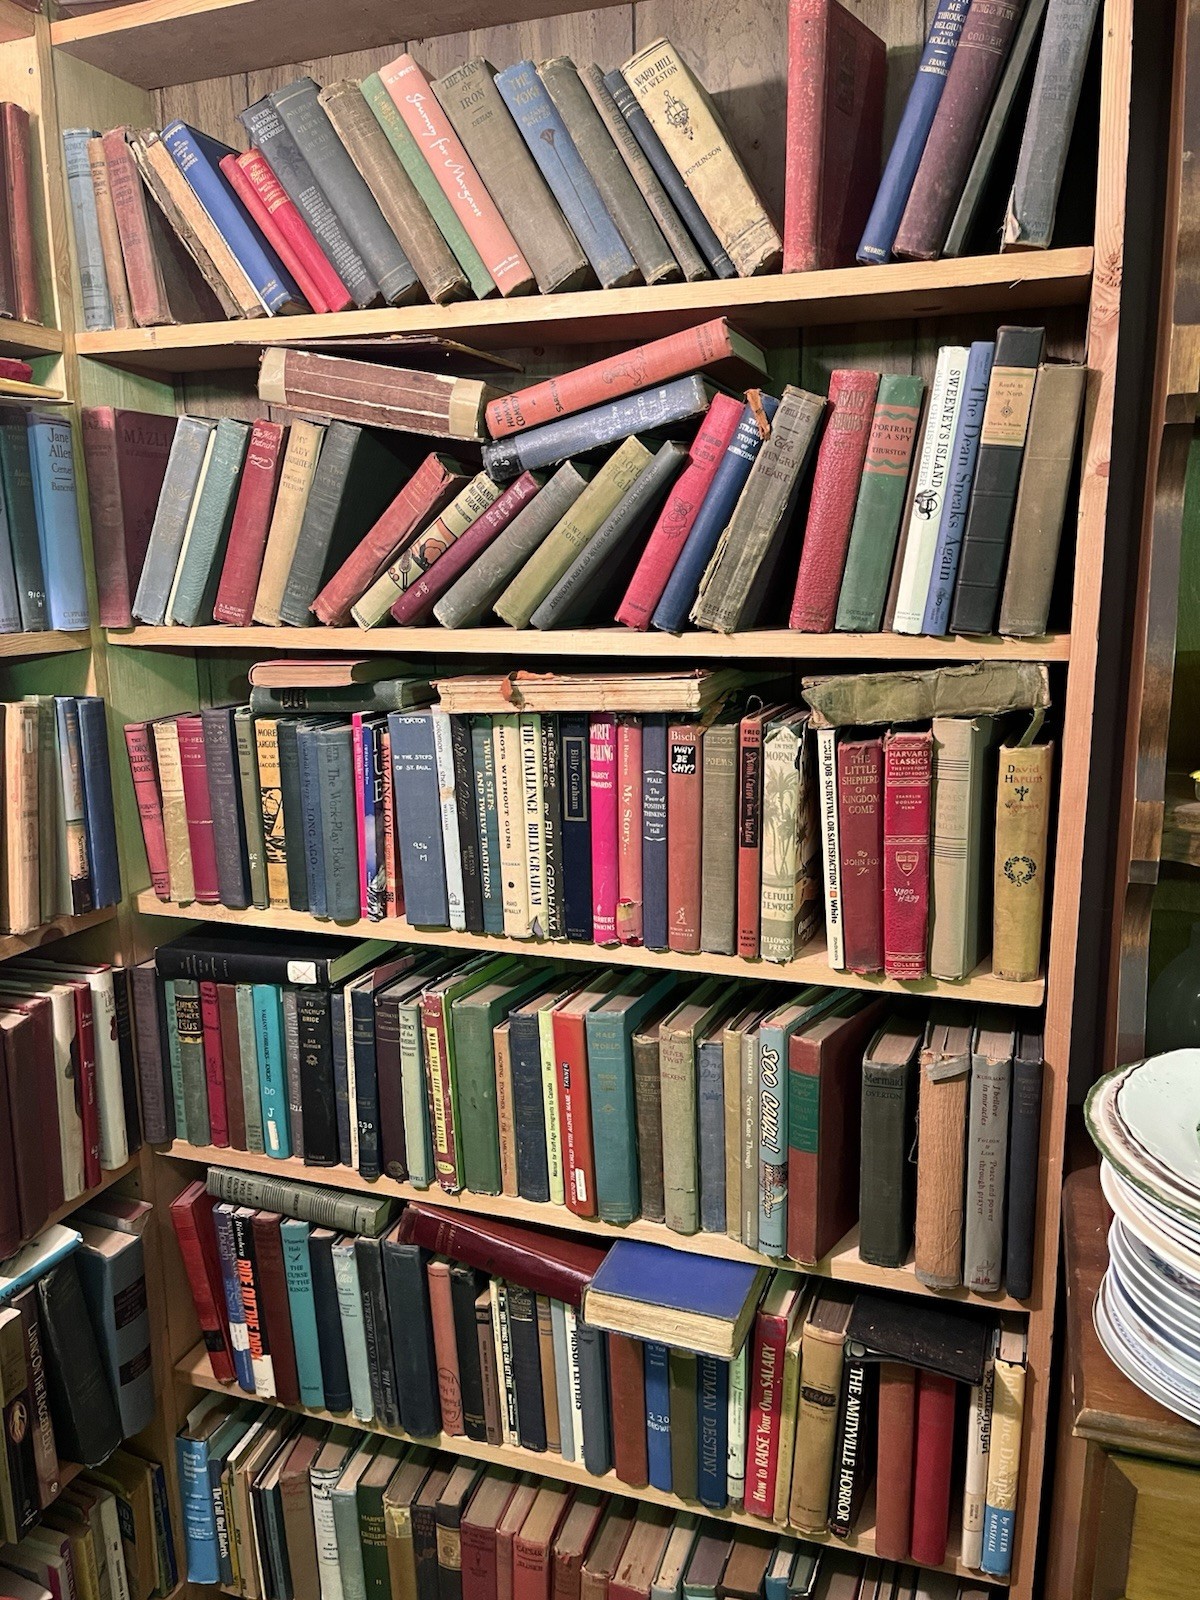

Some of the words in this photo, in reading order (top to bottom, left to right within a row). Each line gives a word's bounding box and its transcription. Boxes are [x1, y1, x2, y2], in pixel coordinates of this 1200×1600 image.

[948, 3, 961, 12] ME
[633, 67, 655, 88] WARD
[656, 55, 674, 74] HILL
[928, 58, 947, 68] FRANK
[442, 73, 458, 91] THE
[456, 63, 480, 83] MAN
[640, 85, 650, 96] AT
[649, 66, 678, 90] WESTON
[460, 88, 486, 110] IRON
[258, 120, 280, 137] SHORT
[612, 113, 621, 126] OF
[404, 92, 437, 136] Journey
[430, 138, 450, 156] for
[444, 159, 483, 218] Margaret
[616, 125, 641, 162] ENGLISH
[684, 146, 722, 178] TOMLINSON
[938, 370, 960, 441] SWEENEY'S
[966, 384, 986, 418] The
[48, 428, 70, 444] Jane
[737, 433, 758, 448] STORY
[872, 423, 913, 434] PORTRAIT
[872, 432, 884, 440] OF
[894, 433, 911, 442] SPY
[959, 423, 980, 466] Dean
[762, 450, 798, 468] HUNGRY
[932, 442, 949, 489] ISLAND
[758, 464, 790, 482] HEART
[464, 496, 480, 514] DEAR
[948, 473, 972, 528] Speaks
[939, 533, 960, 583] Again
[571, 560, 584, 582] FARM
[550, 573, 574, 610] MACHINERY
[258, 728, 276, 738] MORE
[522, 722, 534, 745] THE
[671, 731, 696, 742] Bisch
[482, 738, 494, 778] TWELVE
[570, 748, 579, 772] Billy
[674, 746, 694, 754] WHY
[676, 755, 688, 764] BE
[706, 757, 734, 766] POEMS
[851, 754, 870, 764] THE
[381, 744, 392, 805] AMAZING
[524, 746, 538, 815] CHALLENGE
[672, 764, 694, 774] SHY?
[824, 762, 832, 776] JOB
[842, 776, 880, 785] SHEPHERD
[844, 765, 878, 775] LITTLE
[1008, 764, 1039, 773] David
[476, 770, 484, 794] AND
[502, 764, 510, 816] WITHOUT
[571, 773, 580, 810] Graham
[623, 784, 633, 800] My
[855, 786, 867, 794] OF
[486, 780, 495, 811] STEPS
[826, 780, 834, 822] SURVIVAL
[478, 795, 486, 834] TWELVE
[644, 810, 666, 818] THINKING
[848, 804, 876, 814] COME
[306, 806, 316, 838] LONG
[384, 806, 393, 838] LOVE
[827, 823, 835, 832] OR
[527, 822, 539, 854] BILLY
[545, 819, 554, 862] BILLY
[309, 840, 318, 865] AGO
[334, 844, 344, 879] Books
[844, 858, 866, 866] JOHN
[480, 838, 491, 899] TRADITIONS
[528, 854, 542, 906] GRAHAM
[546, 864, 556, 931] GRAHAM
[769, 943, 790, 952] PRESS
[700, 1069, 721, 1082] Day
[761, 1044, 780, 1088] SOO
[864, 1074, 903, 1086] Mermaid
[865, 1090, 902, 1100] OVERTON
[992, 1092, 1000, 1118] believe
[980, 1092, 988, 1126] miracles
[760, 1091, 780, 1154] CANAL!
[990, 1160, 998, 1181] Peace
[976, 1190, 984, 1216] prayer
[988, 1198, 996, 1222] power
[218, 1226, 229, 1261] Hough
[237, 1259, 254, 1286] RIDE
[362, 1290, 374, 1342] HORSEBACK
[760, 1343, 776, 1390] SALARY
[34, 1372, 45, 1392] THE
[702, 1356, 717, 1412] HUMAN
[850, 1368, 864, 1393] THE
[759, 1390, 772, 1411] Own
[758, 1414, 772, 1433] Your
[842, 1396, 861, 1467] AMITYVILLE
[702, 1416, 717, 1478] DESTINY
[755, 1434, 770, 1468] RAISE
[756, 1470, 768, 1484] to
[752, 1484, 766, 1502] How
[836, 1468, 854, 1522] HORROR
[988, 1514, 998, 1552] MARSHALL
[1004, 1516, 1010, 1526] by
[1000, 1527, 1009, 1552] PETER
